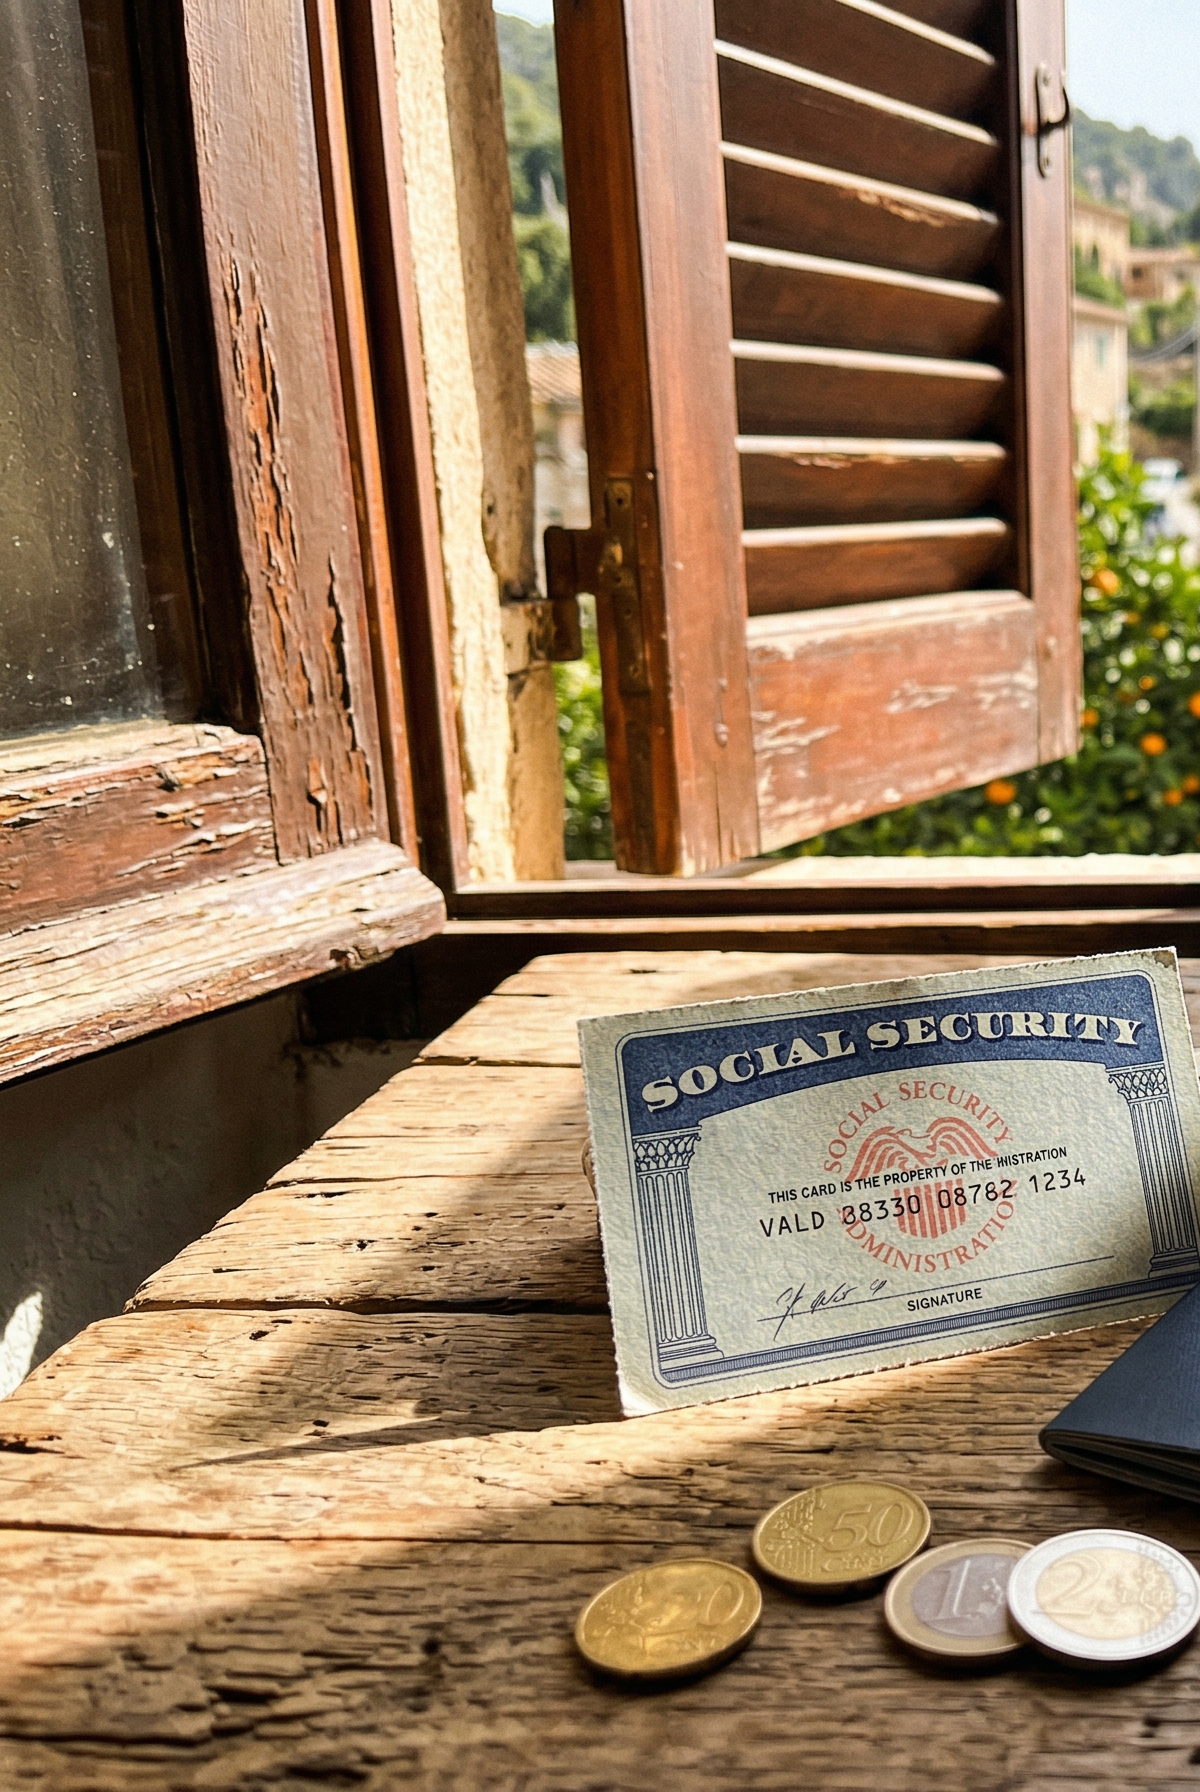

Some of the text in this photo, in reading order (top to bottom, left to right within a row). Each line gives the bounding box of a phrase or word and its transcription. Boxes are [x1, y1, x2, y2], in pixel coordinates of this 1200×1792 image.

[641, 1011, 1142, 1113] SOCIAL SECURITY
[823, 1080, 1014, 1174] SOCIAL SECURITY
[759, 1211, 825, 1238] VALD
[937, 1179, 1014, 1209] 08782
[1028, 1167, 1087, 1193] 1234
[768, 1189, 798, 1204] THIS
[801, 1183, 836, 1199] CARD
[840, 1181, 852, 1193] IS
[855, 1175, 881, 1190] THE
[883, 1165, 947, 1186] PROPERTY
[950, 1162, 967, 1176] OF
[907, 1287, 983, 1312] SIGNATURE
[821, 1502, 914, 1553] 50
[922, 1559, 975, 1622] 1
[1030, 1554, 1102, 1617] 2
